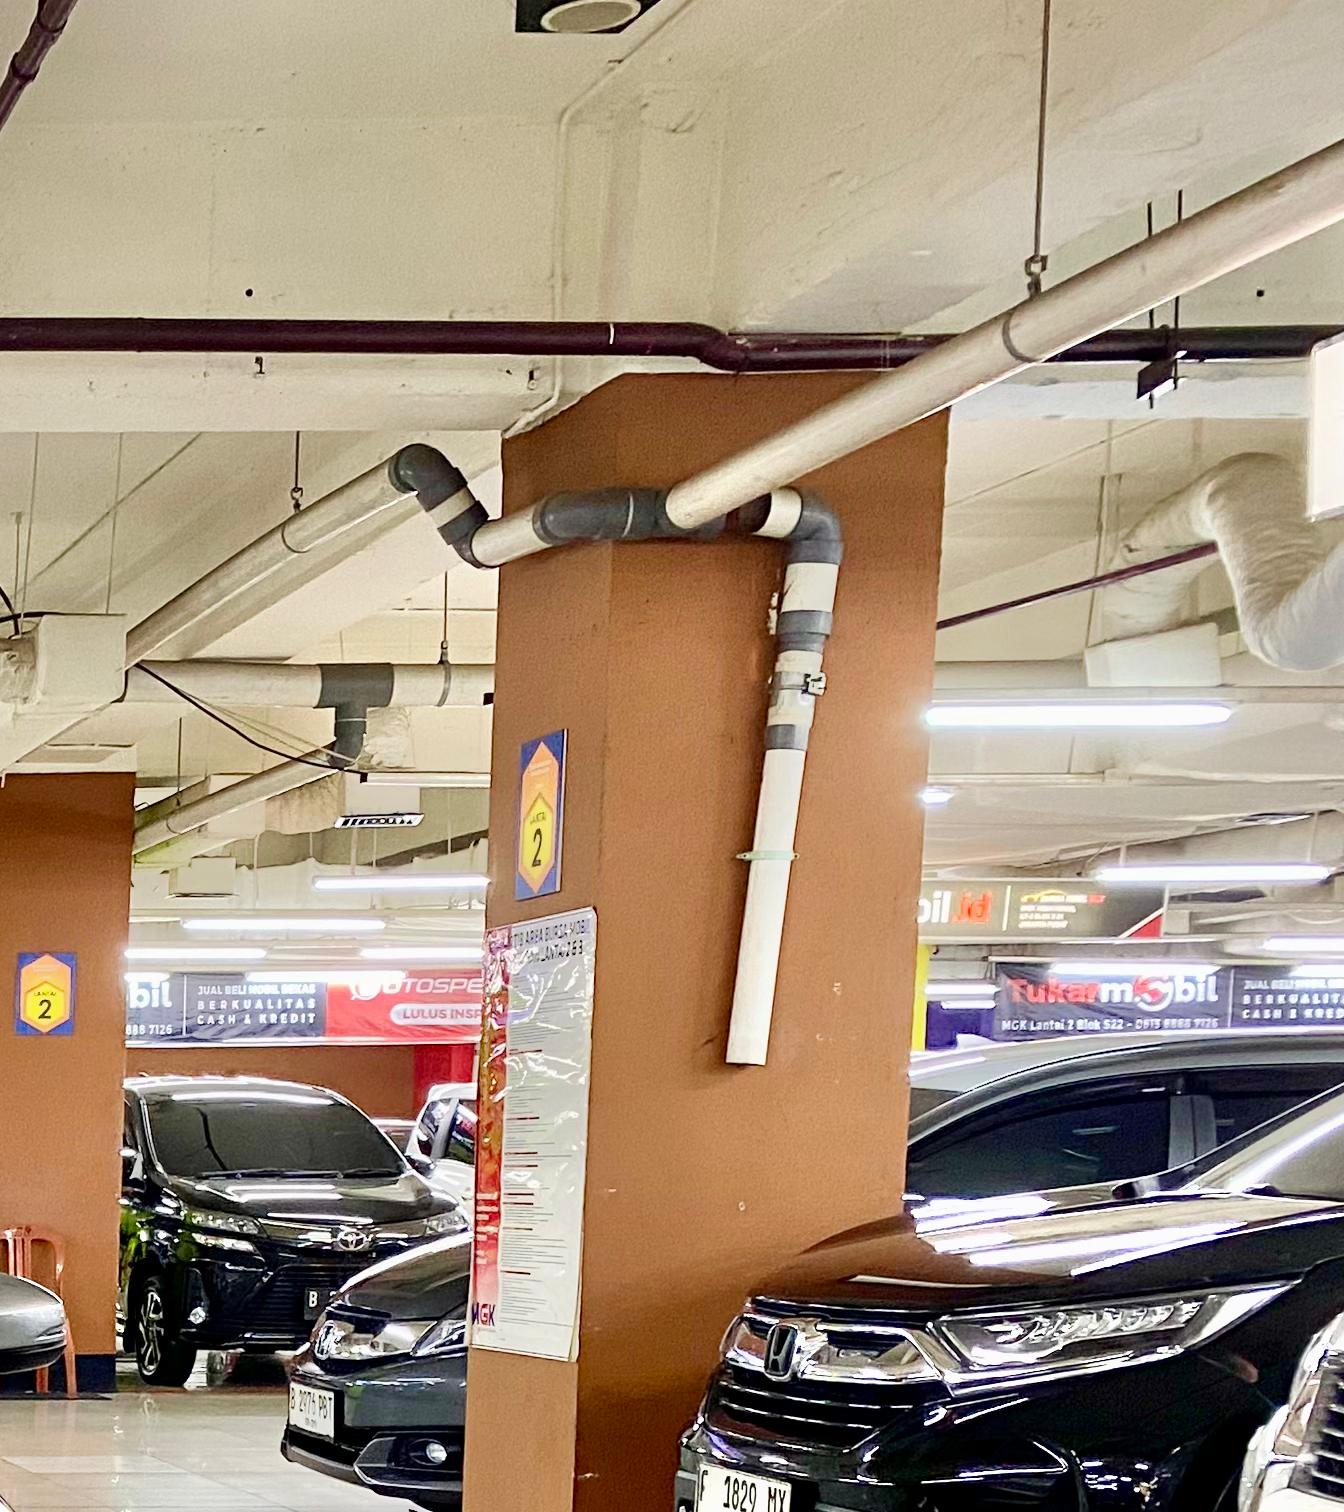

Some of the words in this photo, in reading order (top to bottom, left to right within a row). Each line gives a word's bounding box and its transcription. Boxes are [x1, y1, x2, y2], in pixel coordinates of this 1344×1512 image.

[531, 828, 543, 867] 2
[197, 985, 223, 996] JUAL
[225, 985, 247, 995] BELI
[38, 999, 52, 1019] 2
[197, 998, 316, 1011] BERKUALITAS
[197, 1013, 236, 1025] CASH
[259, 1013, 316, 1024] KREDIT
[403, 1008, 447, 1019] LULUS
[1002, 1020, 1027, 1031] MGK
[1030, 1019, 1066, 1031] Lantai
[1067, 1019, 1074, 1030] 2
[1103, 1018, 1124, 1030] S22
[308, 1291, 318, 1308] B
[699, 1469, 709, 1502] F
